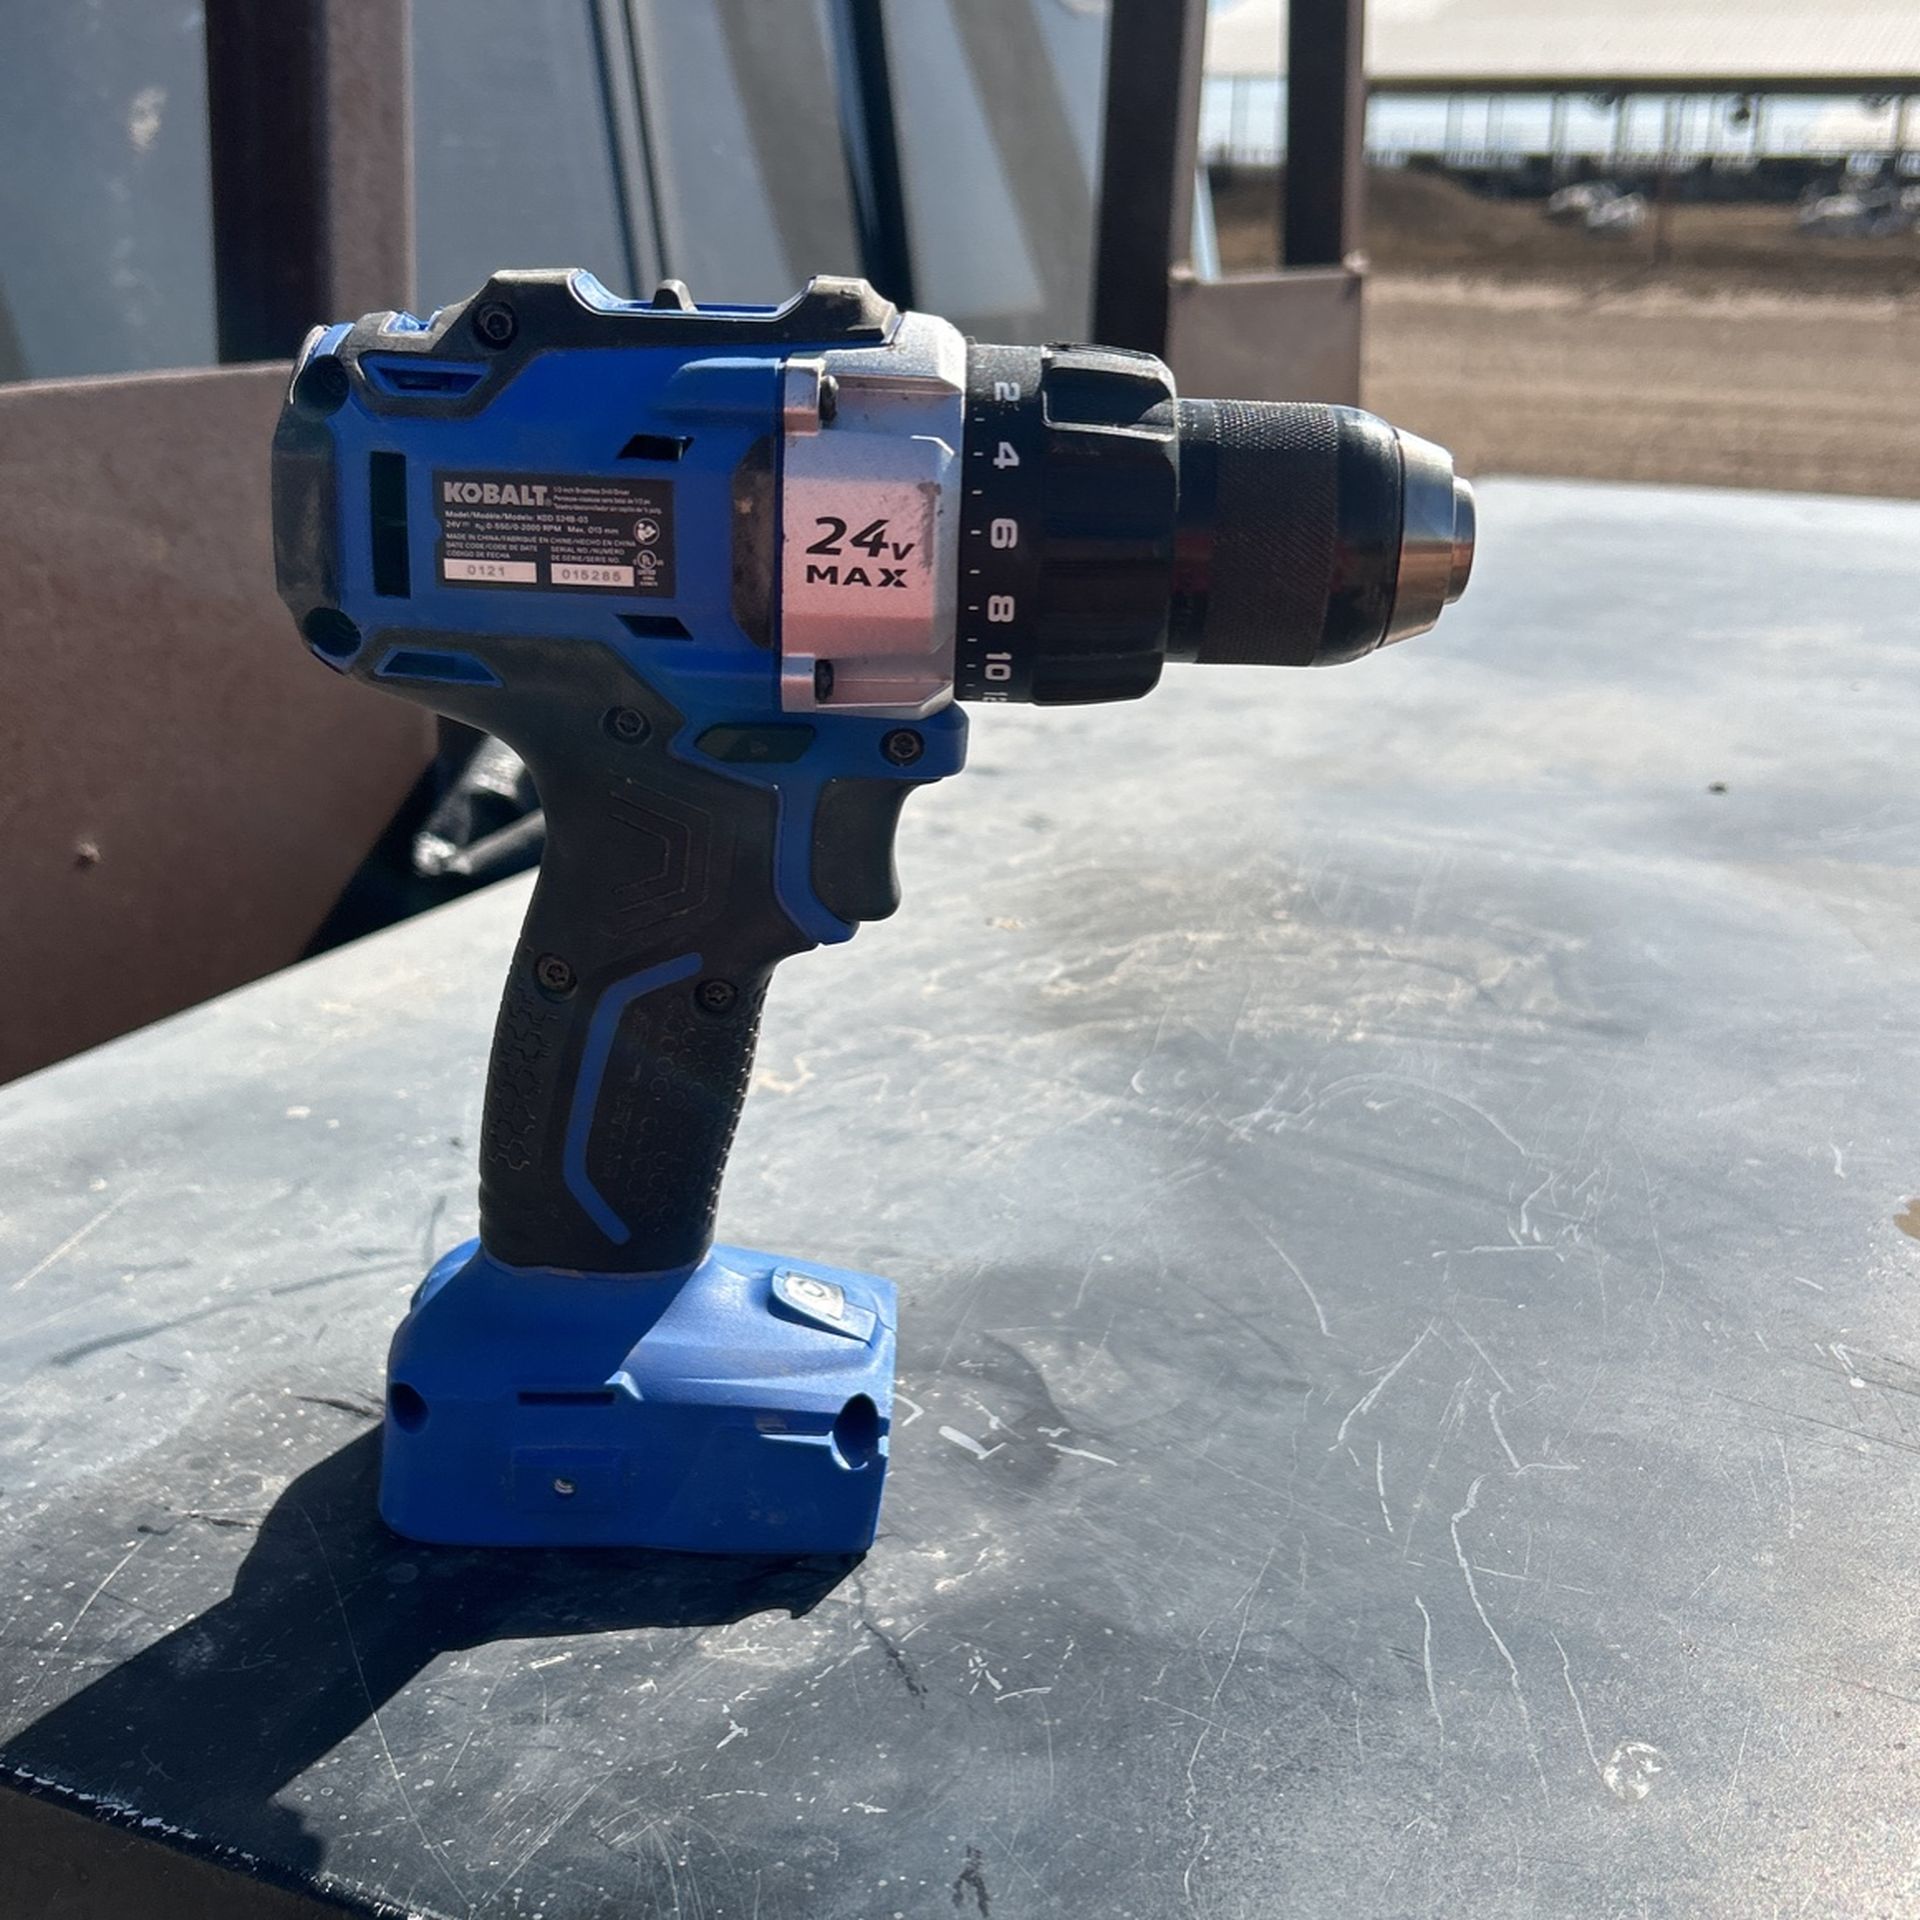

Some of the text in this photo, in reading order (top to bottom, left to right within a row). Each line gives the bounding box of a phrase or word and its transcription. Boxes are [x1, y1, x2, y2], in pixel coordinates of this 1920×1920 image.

[994, 382, 1020, 401] 2
[993, 441, 1020, 469] 4
[444, 482, 548, 506] KOBALT
[990, 518, 1018, 549] 6
[466, 564, 506, 577] 0121
[806, 564, 908, 588] MAX
[987, 595, 1015, 623] 8
[985, 652, 1012, 681] 10
